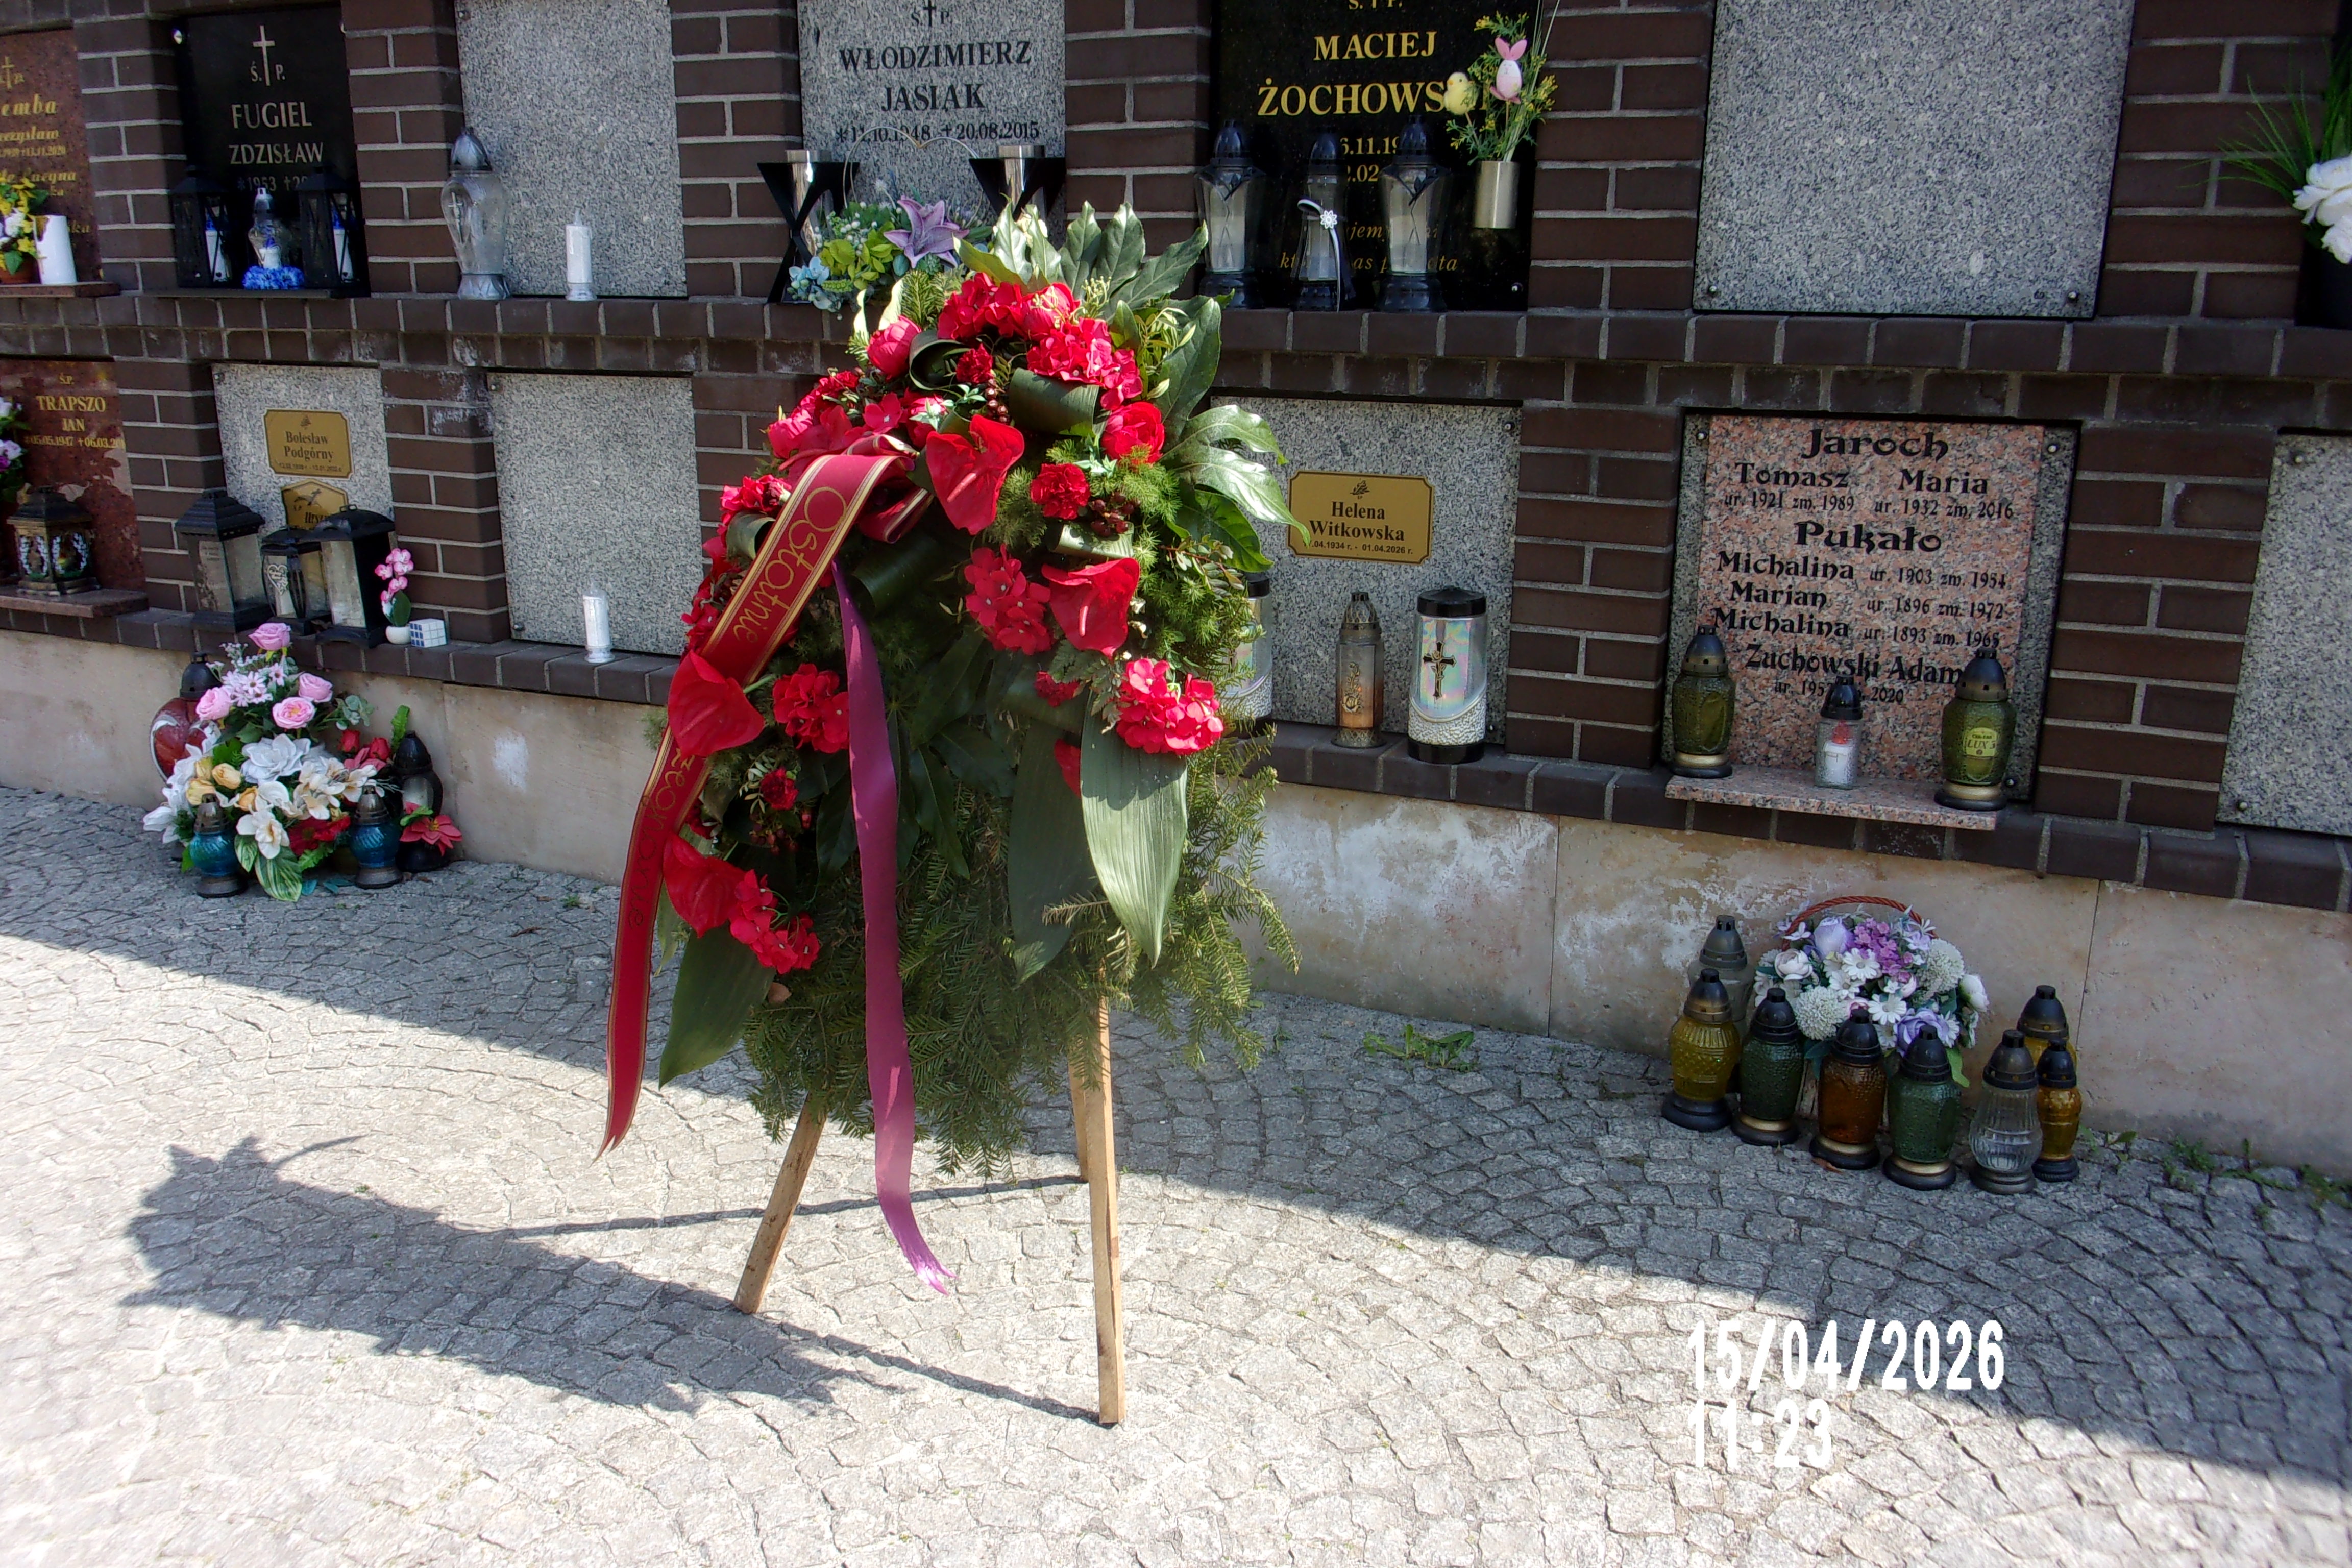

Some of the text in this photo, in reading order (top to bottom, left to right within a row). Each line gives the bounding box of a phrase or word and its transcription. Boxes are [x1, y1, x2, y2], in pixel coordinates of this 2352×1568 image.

[839, 41, 1031, 71] WŁODZIMIERZ
[1313, 31, 1437, 61] MACIEJ
[1, 93, 57, 117] emba
[881, 83, 985, 112] JASIAK
[231, 102, 312, 128] FUGIEL
[228, 142, 323, 164] ZDZISŁAW
[36, 395, 106, 412] TRAPSZO
[62, 418, 85, 432] JAN
[1801, 429, 1949, 460] Jaroch
[1735, 462, 1989, 495] Tomasz Maria
[1331, 501, 1385, 520] Helena
[1752, 491, 1783, 509] 1921
[1823, 495, 1854, 511] 1989
[1903, 498, 1938, 516] 1932
[1309, 520, 1405, 541] Witkowska
[1794, 521, 1942, 555] Pukało
[1362, 544, 1405, 554] 01.04.2026
[732, 485, 849, 644] Ostatnie
[1717, 550, 1854, 580] Michalina
[1898, 567, 1932, 585] 1903
[1729, 580, 1827, 611] Marian
[1895, 598, 1930, 615] 1896
[1713, 607, 1849, 639] Michalina
[1893, 626, 1926, 644] 1893
[1745, 638, 1963, 686] Żuchowski Adam
